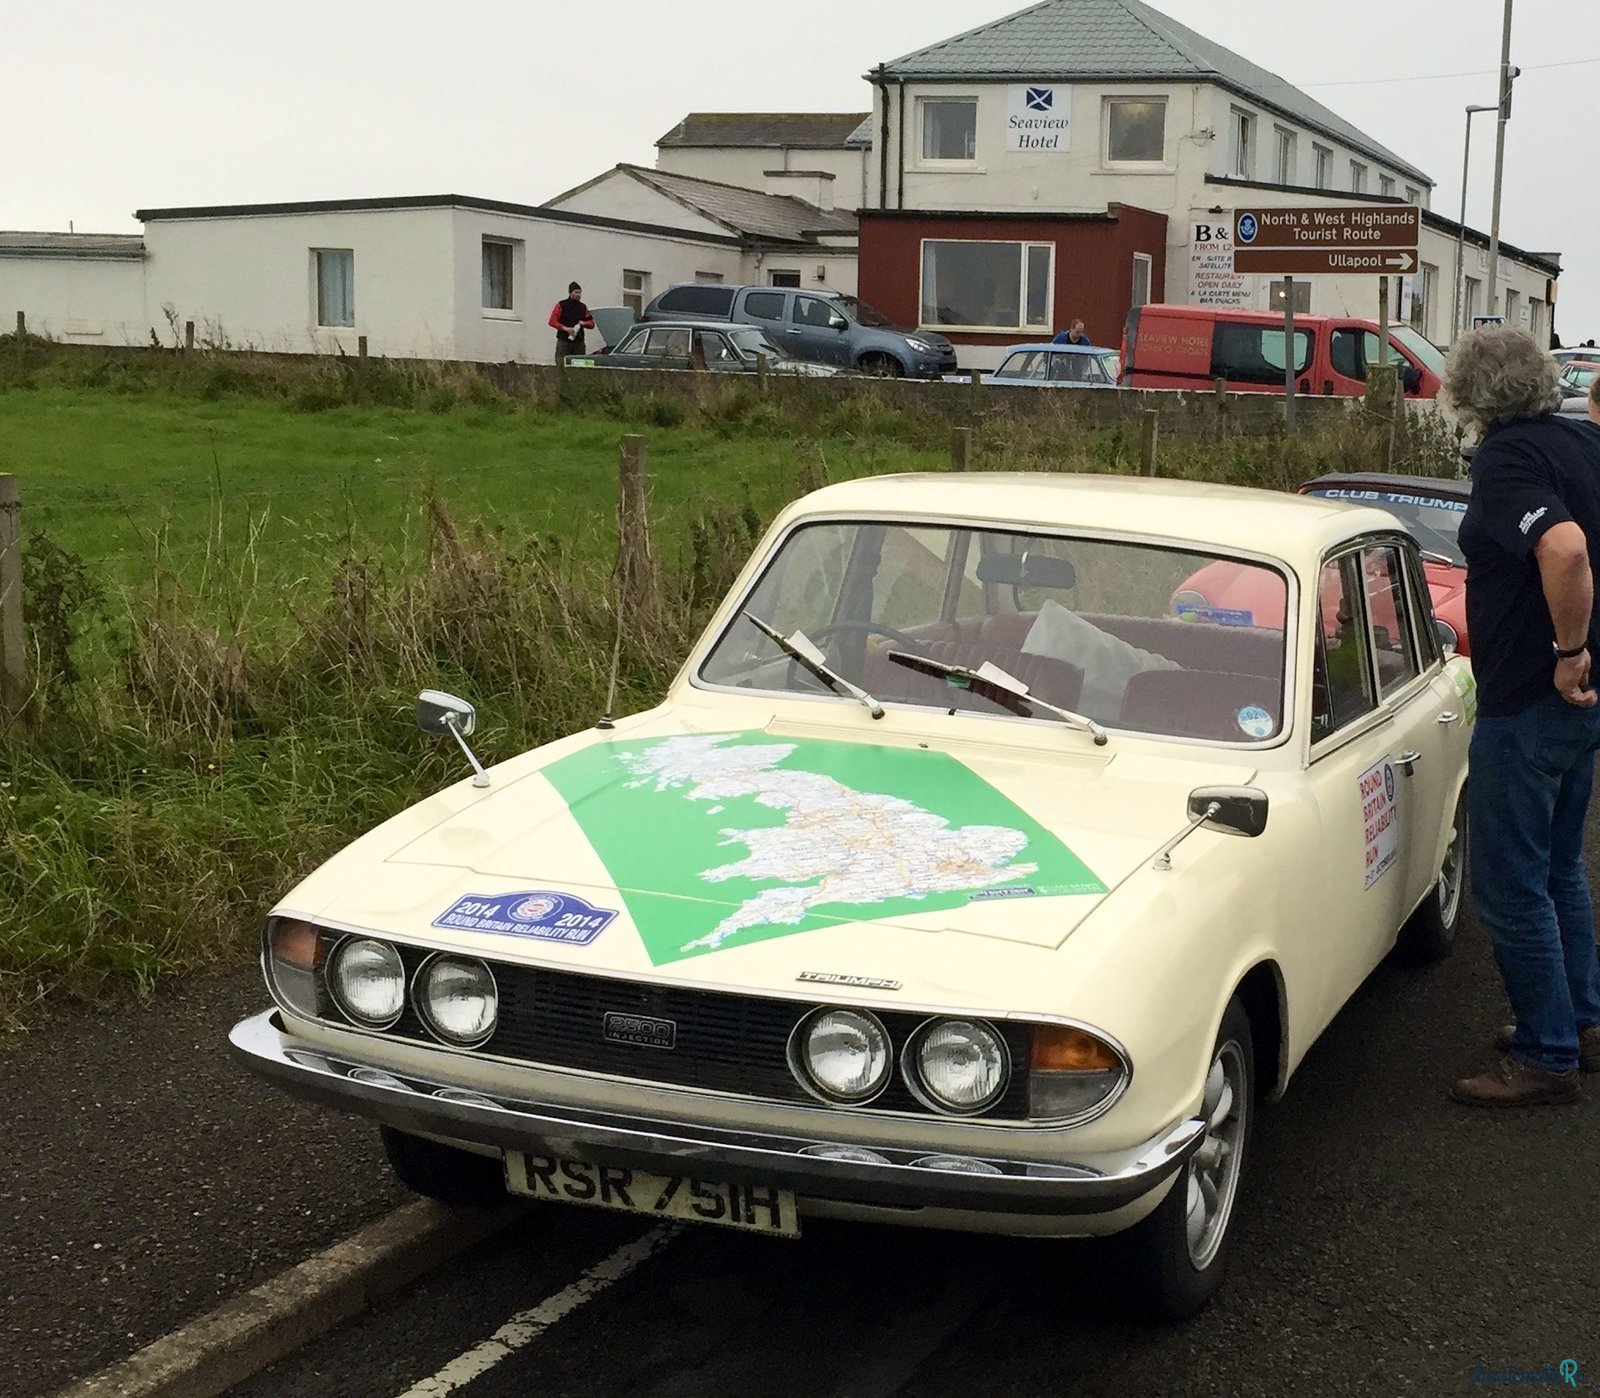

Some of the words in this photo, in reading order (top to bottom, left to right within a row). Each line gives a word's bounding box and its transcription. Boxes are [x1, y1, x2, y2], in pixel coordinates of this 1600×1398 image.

[1009, 115, 1069, 129] Seaview
[1019, 134, 1059, 148] Hotel
[1261, 213, 1298, 225] North
[1301, 212, 1310, 225] &
[1313, 212, 1345, 225] West
[1351, 211, 1416, 227] Highlands
[1195, 225, 1212, 242] B
[1215, 227, 1229, 240] &
[1293, 227, 1338, 240] Tourist
[1343, 227, 1382, 240] Route
[1195, 243, 1219, 251] FROM
[1328, 253, 1383, 269] Ullapool
[1197, 281, 1220, 289] OPEN
[1221, 281, 1243, 289] DAILY
[1232, 290, 1251, 298] MENU
[1181, 336, 1209, 347] HOTEL
[1325, 489, 1379, 500] CLUB
[1387, 493, 1469, 513] TRIUMP
[454, 901, 502, 919] 2014
[554, 912, 604, 928] 2014
[441, 912, 480, 928] ROUND
[475, 918, 515, 932] BRITAIN
[510, 923, 570, 938] RELIABILITY
[564, 927, 592, 941] RUN
[797, 971, 902, 990] TRIUMPH
[608, 1016, 671, 1040] 2500
[608, 1031, 669, 1046] INJECTION
[523, 1152, 636, 1208] RSR
[652, 1176, 782, 1230] 751H
